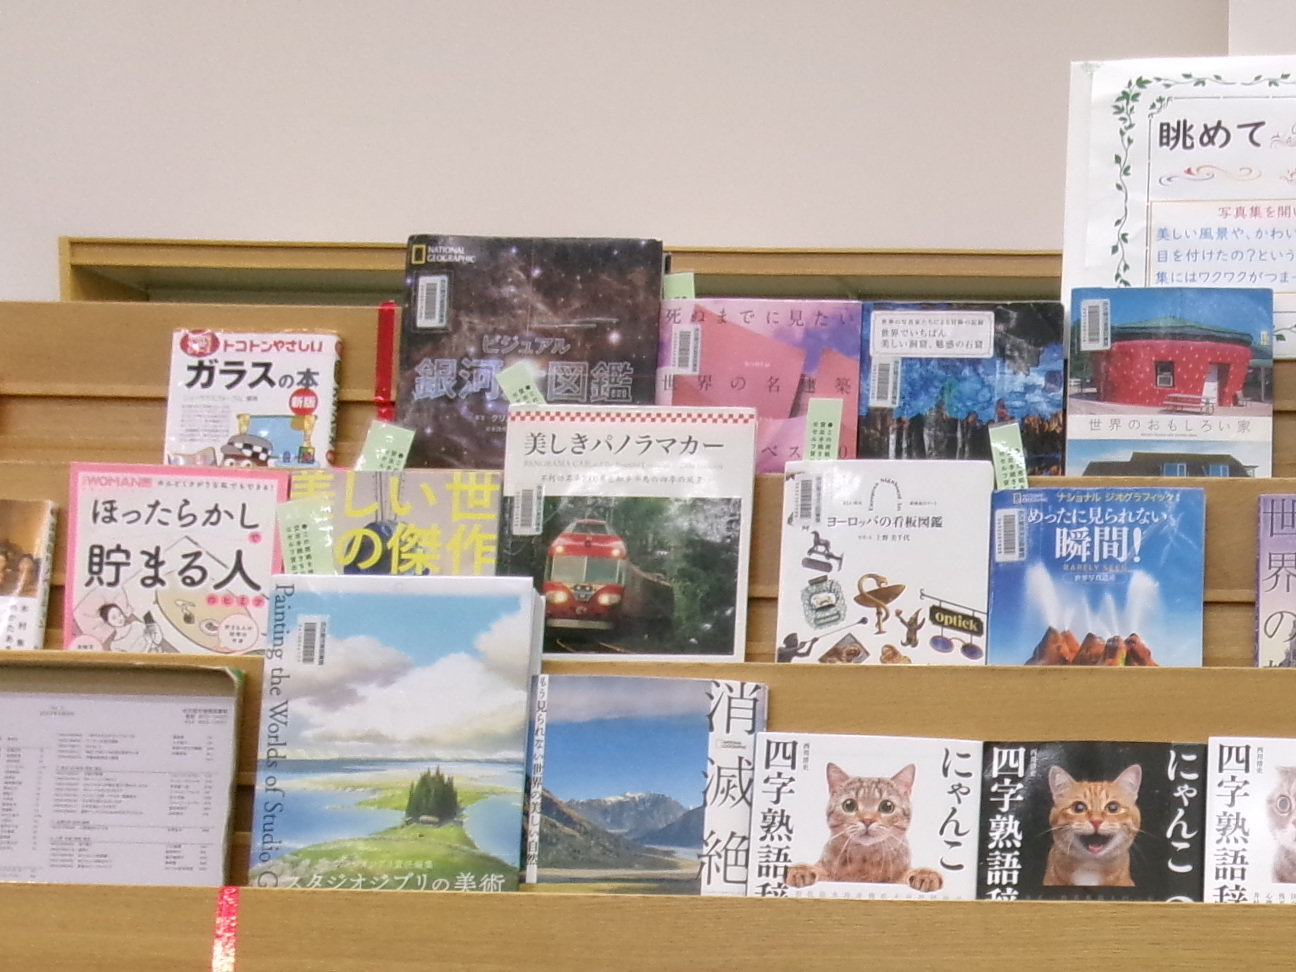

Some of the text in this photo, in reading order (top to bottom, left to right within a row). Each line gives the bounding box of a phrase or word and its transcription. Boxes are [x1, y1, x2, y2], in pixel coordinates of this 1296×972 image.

[1157, 117, 1267, 151] 眺めて
[426, 254, 476, 264] GEOGRAPHIC
[427, 245, 466, 255] NATIONAL
[664, 306, 857, 331] 死ぬまでに見たい
[222, 339, 323, 353] トコトンやさしい
[481, 335, 571, 356] ビジュアル
[881, 328, 947, 338] 世界でいちばん
[184, 358, 320, 391] ガラスの本
[412, 357, 634, 402] 銀河図鑑
[660, 371, 853, 398] 世界の名建築
[291, 396, 316, 409] 新版
[1087, 418, 1253, 435] 世界のおもしろい家
[524, 432, 726, 457] 美しきパノラマカー
[1056, 492, 1101, 503] ナショナル
[1104, 492, 1175, 503] ジオグラフィック
[91, 498, 260, 530] ほったらかし
[826, 515, 944, 530] ヨーロッパの看板図鑑
[1027, 507, 1169, 526] めったに見られない
[336, 524, 500, 576] の傑作
[84, 543, 263, 592] 貯まる人
[1063, 564, 1099, 572] RARELY
[265, 582, 296, 660] Painting
[269, 666, 291, 697] the
[265, 700, 289, 770] Worlds
[526, 676, 549, 867] もう見られない世界の美しい自然
[696, 680, 763, 888] 消滅絶
[266, 773, 287, 798] of
[937, 747, 973, 871] にゃんこ
[258, 801, 285, 864] Studio
